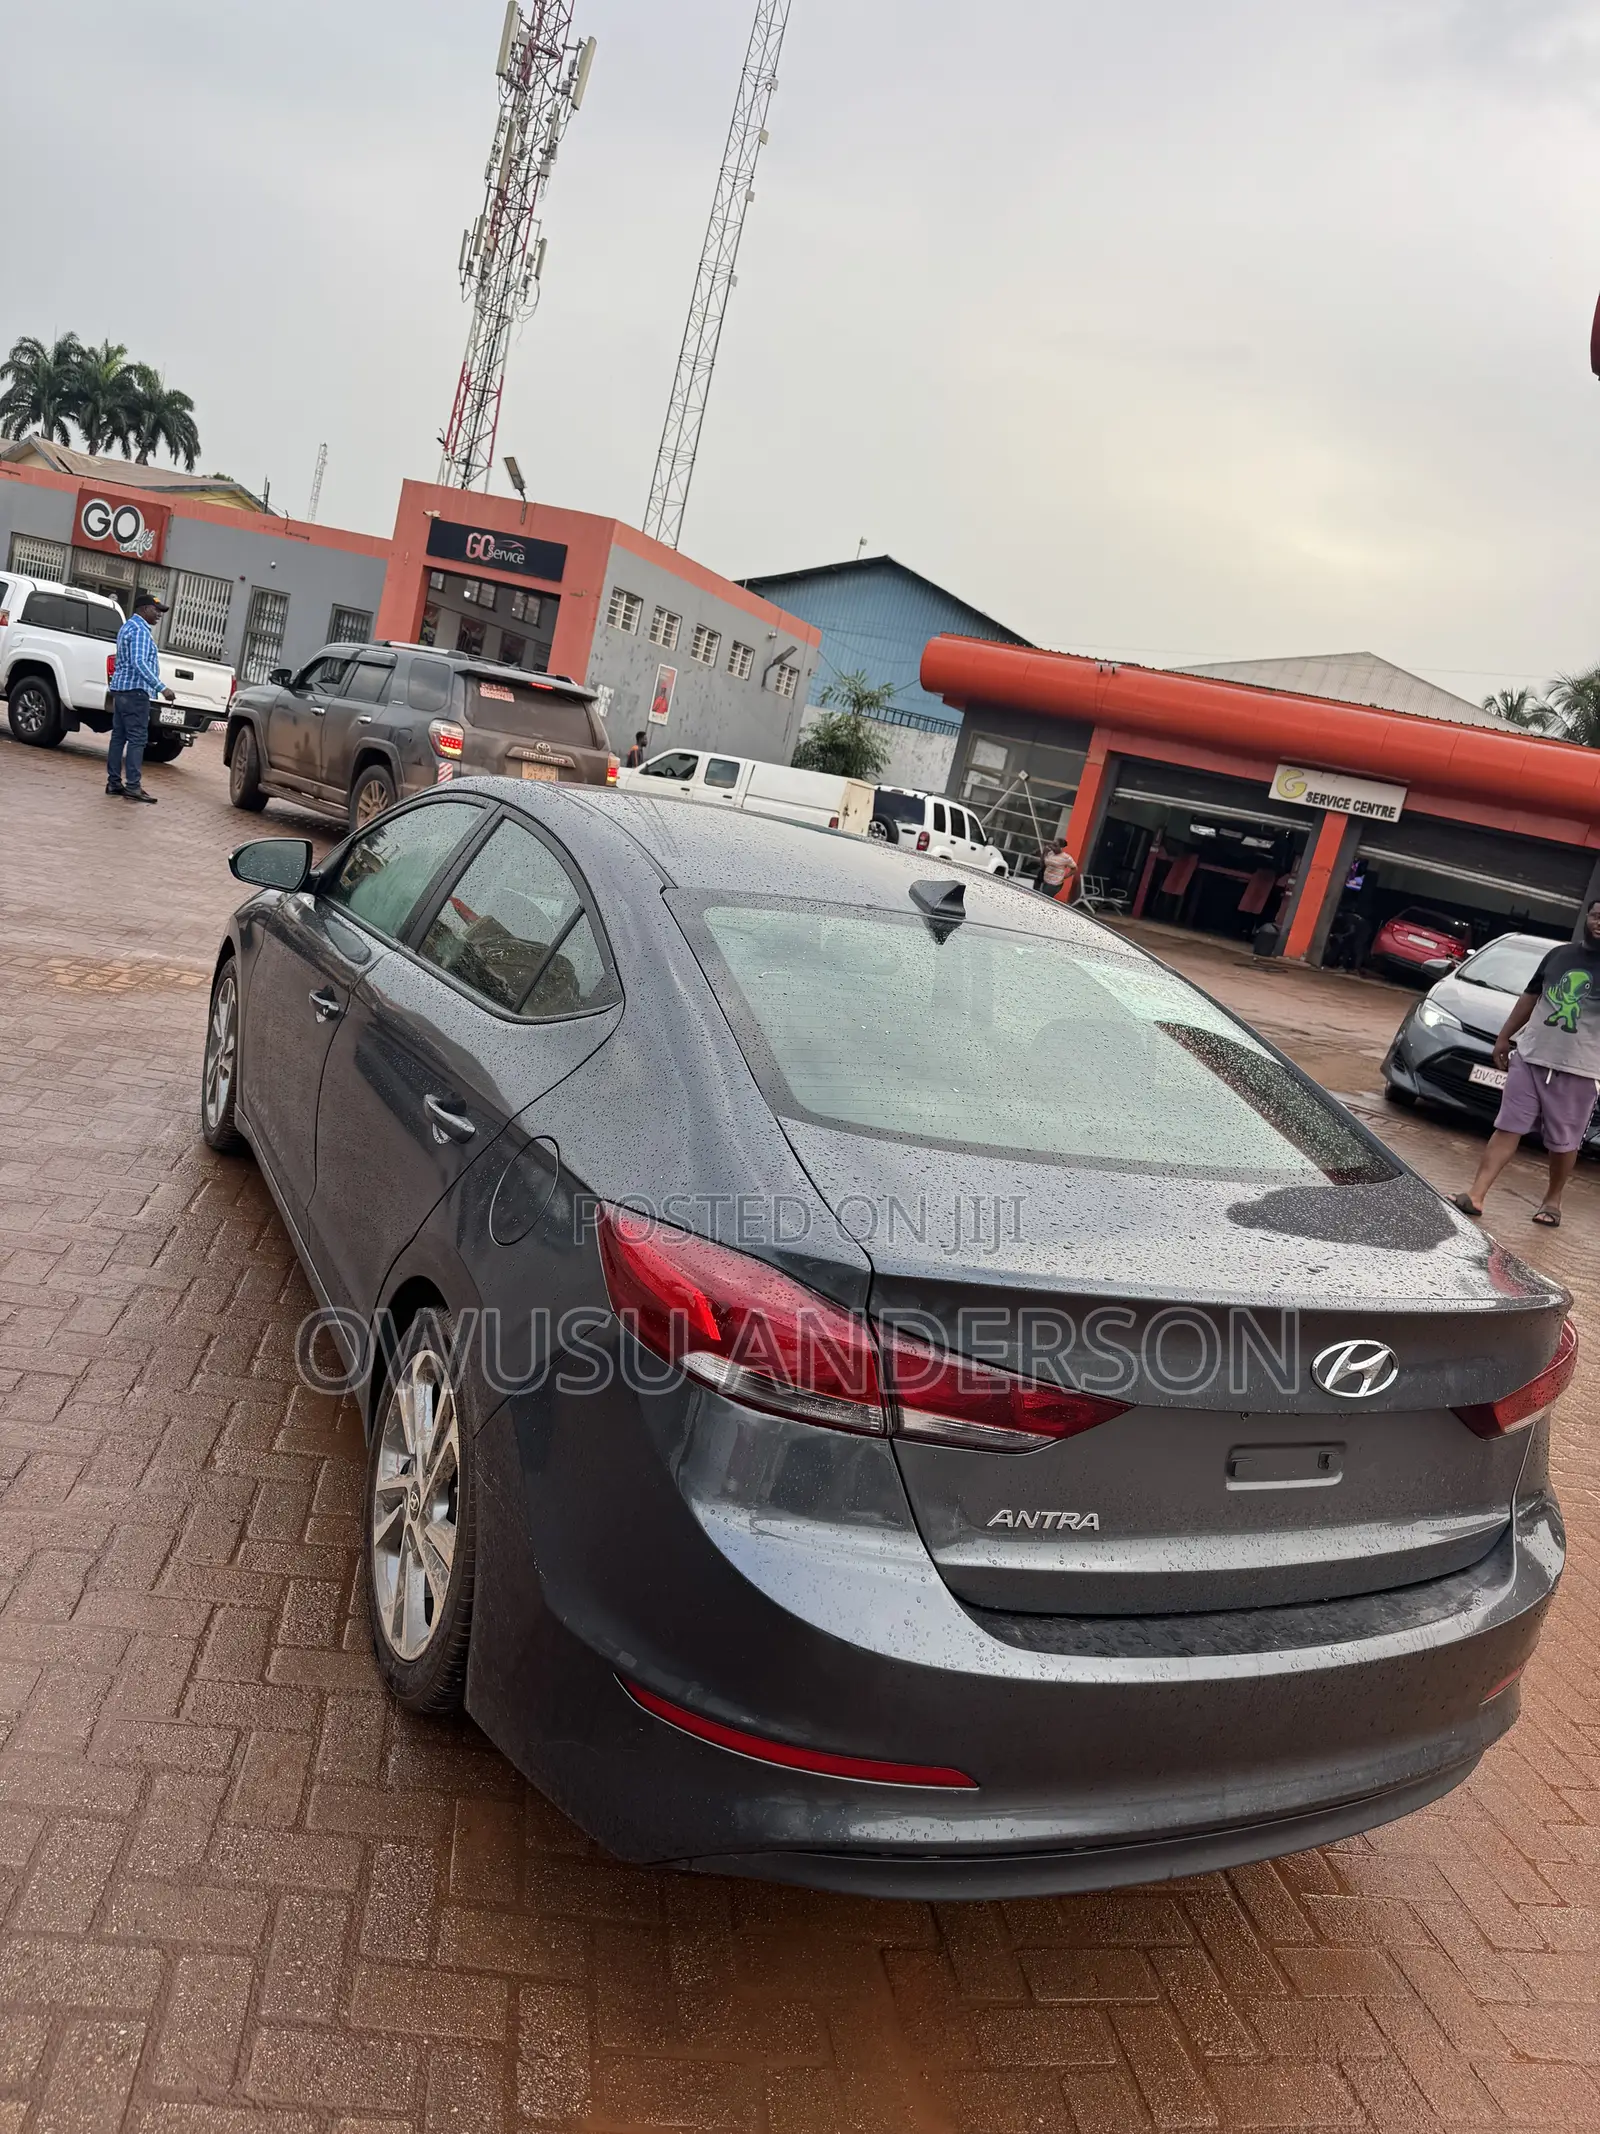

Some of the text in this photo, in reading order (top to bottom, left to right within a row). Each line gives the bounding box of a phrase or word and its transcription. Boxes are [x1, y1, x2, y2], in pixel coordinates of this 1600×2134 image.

[82, 499, 145, 544] GO
[466, 532, 495, 561] GO
[1305, 791, 1397, 819] SERVICE CENTRE
[986, 1509, 1100, 1531] ANTRA
